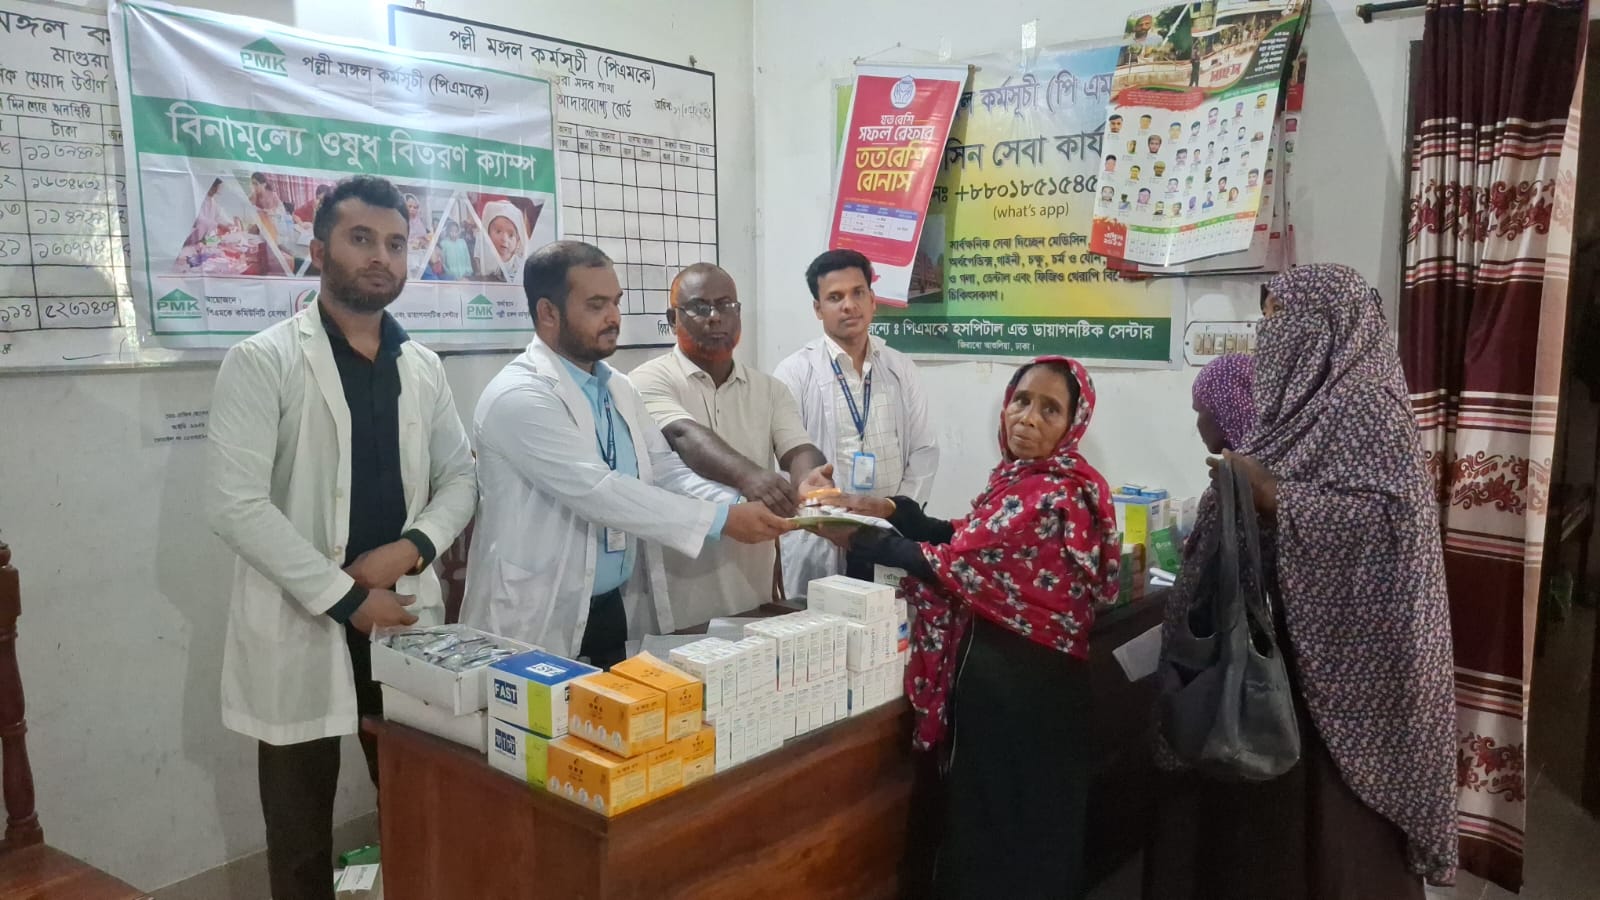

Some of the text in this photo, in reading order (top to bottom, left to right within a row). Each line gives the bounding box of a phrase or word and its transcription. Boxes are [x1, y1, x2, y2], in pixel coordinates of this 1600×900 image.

[449, 26, 476, 53] পল্লী
[486, 37, 523, 61] মঙ্গল
[50, 46, 109, 70] মাগুরা
[240, 51, 287, 72] PMK
[302, 53, 333, 76] পল্লী
[337, 61, 373, 82] মঙ্গল
[428, 74, 489, 104] (পিএমকে)
[612, 100, 632, 119] বোর্ড
[51, 120, 77, 138] টাকা
[858, 125, 936, 142] সফল রেফার
[165, 101, 536, 181] বিনামূল্যে ওষুধ বিতরণ ক্যাম্প
[992, 134, 1047, 167] সেবা
[1054, 121, 1107, 161] কার্য
[857, 169, 916, 193] বোনাস
[955, 174, 1098, 202] +৮৮০১৮৫১৫৪৫
[993, 202, 1069, 219] (what's app)
[993, 238, 1011, 249] সেবা
[1069, 255, 1076, 264] ও
[1013, 272, 1031, 284] এবং
[157, 301, 200, 311] PMK
[467, 305, 493, 316] PMK
[903, 318, 949, 336] পিএমকে
[952, 318, 1004, 337] হসপিটাল
[1007, 323, 1029, 336] এন্ড
[1109, 320, 1154, 340] সেন্টার
[494, 683, 518, 703] FAST
